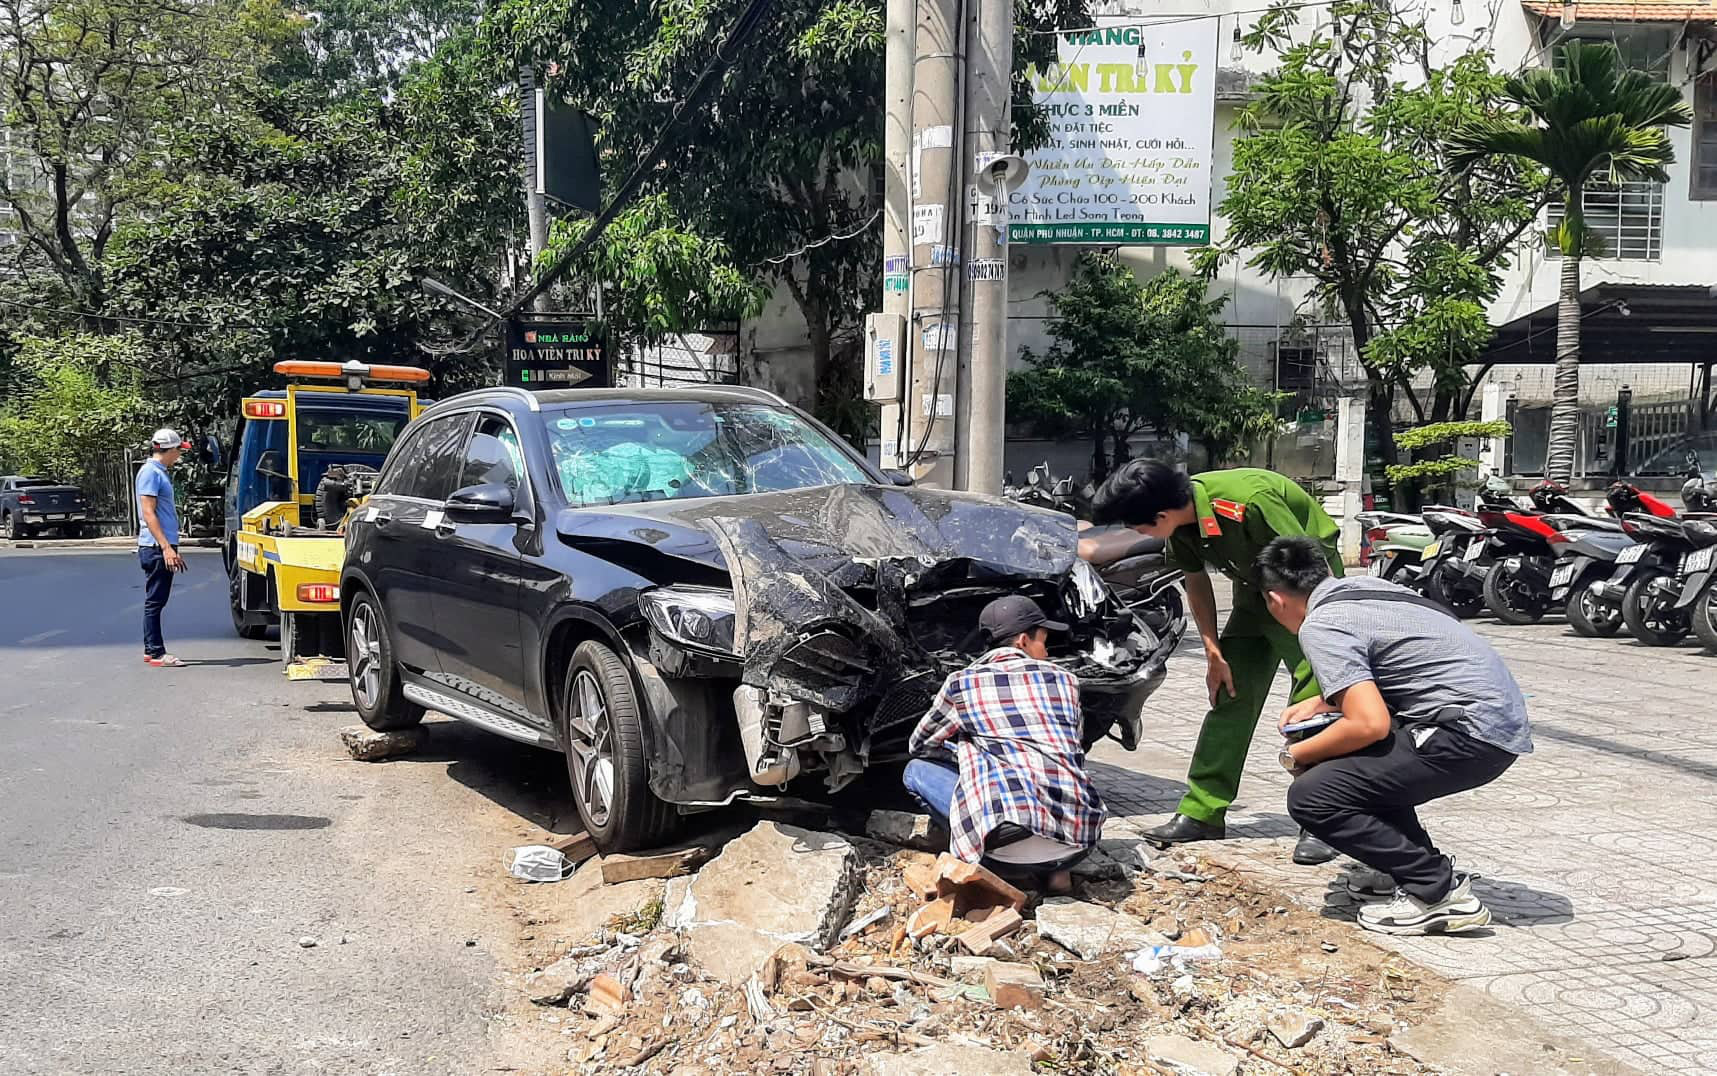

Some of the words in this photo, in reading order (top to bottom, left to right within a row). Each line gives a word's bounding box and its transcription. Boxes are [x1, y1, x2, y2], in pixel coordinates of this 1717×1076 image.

[1084, 104, 1093, 116] 3
[1069, 139, 1095, 149] SINH
[1129, 193, 1158, 204] 200
[1056, 207, 1076, 220] Led
[1106, 228, 1124, 238] HCM
[512, 348, 535, 361] HOA
